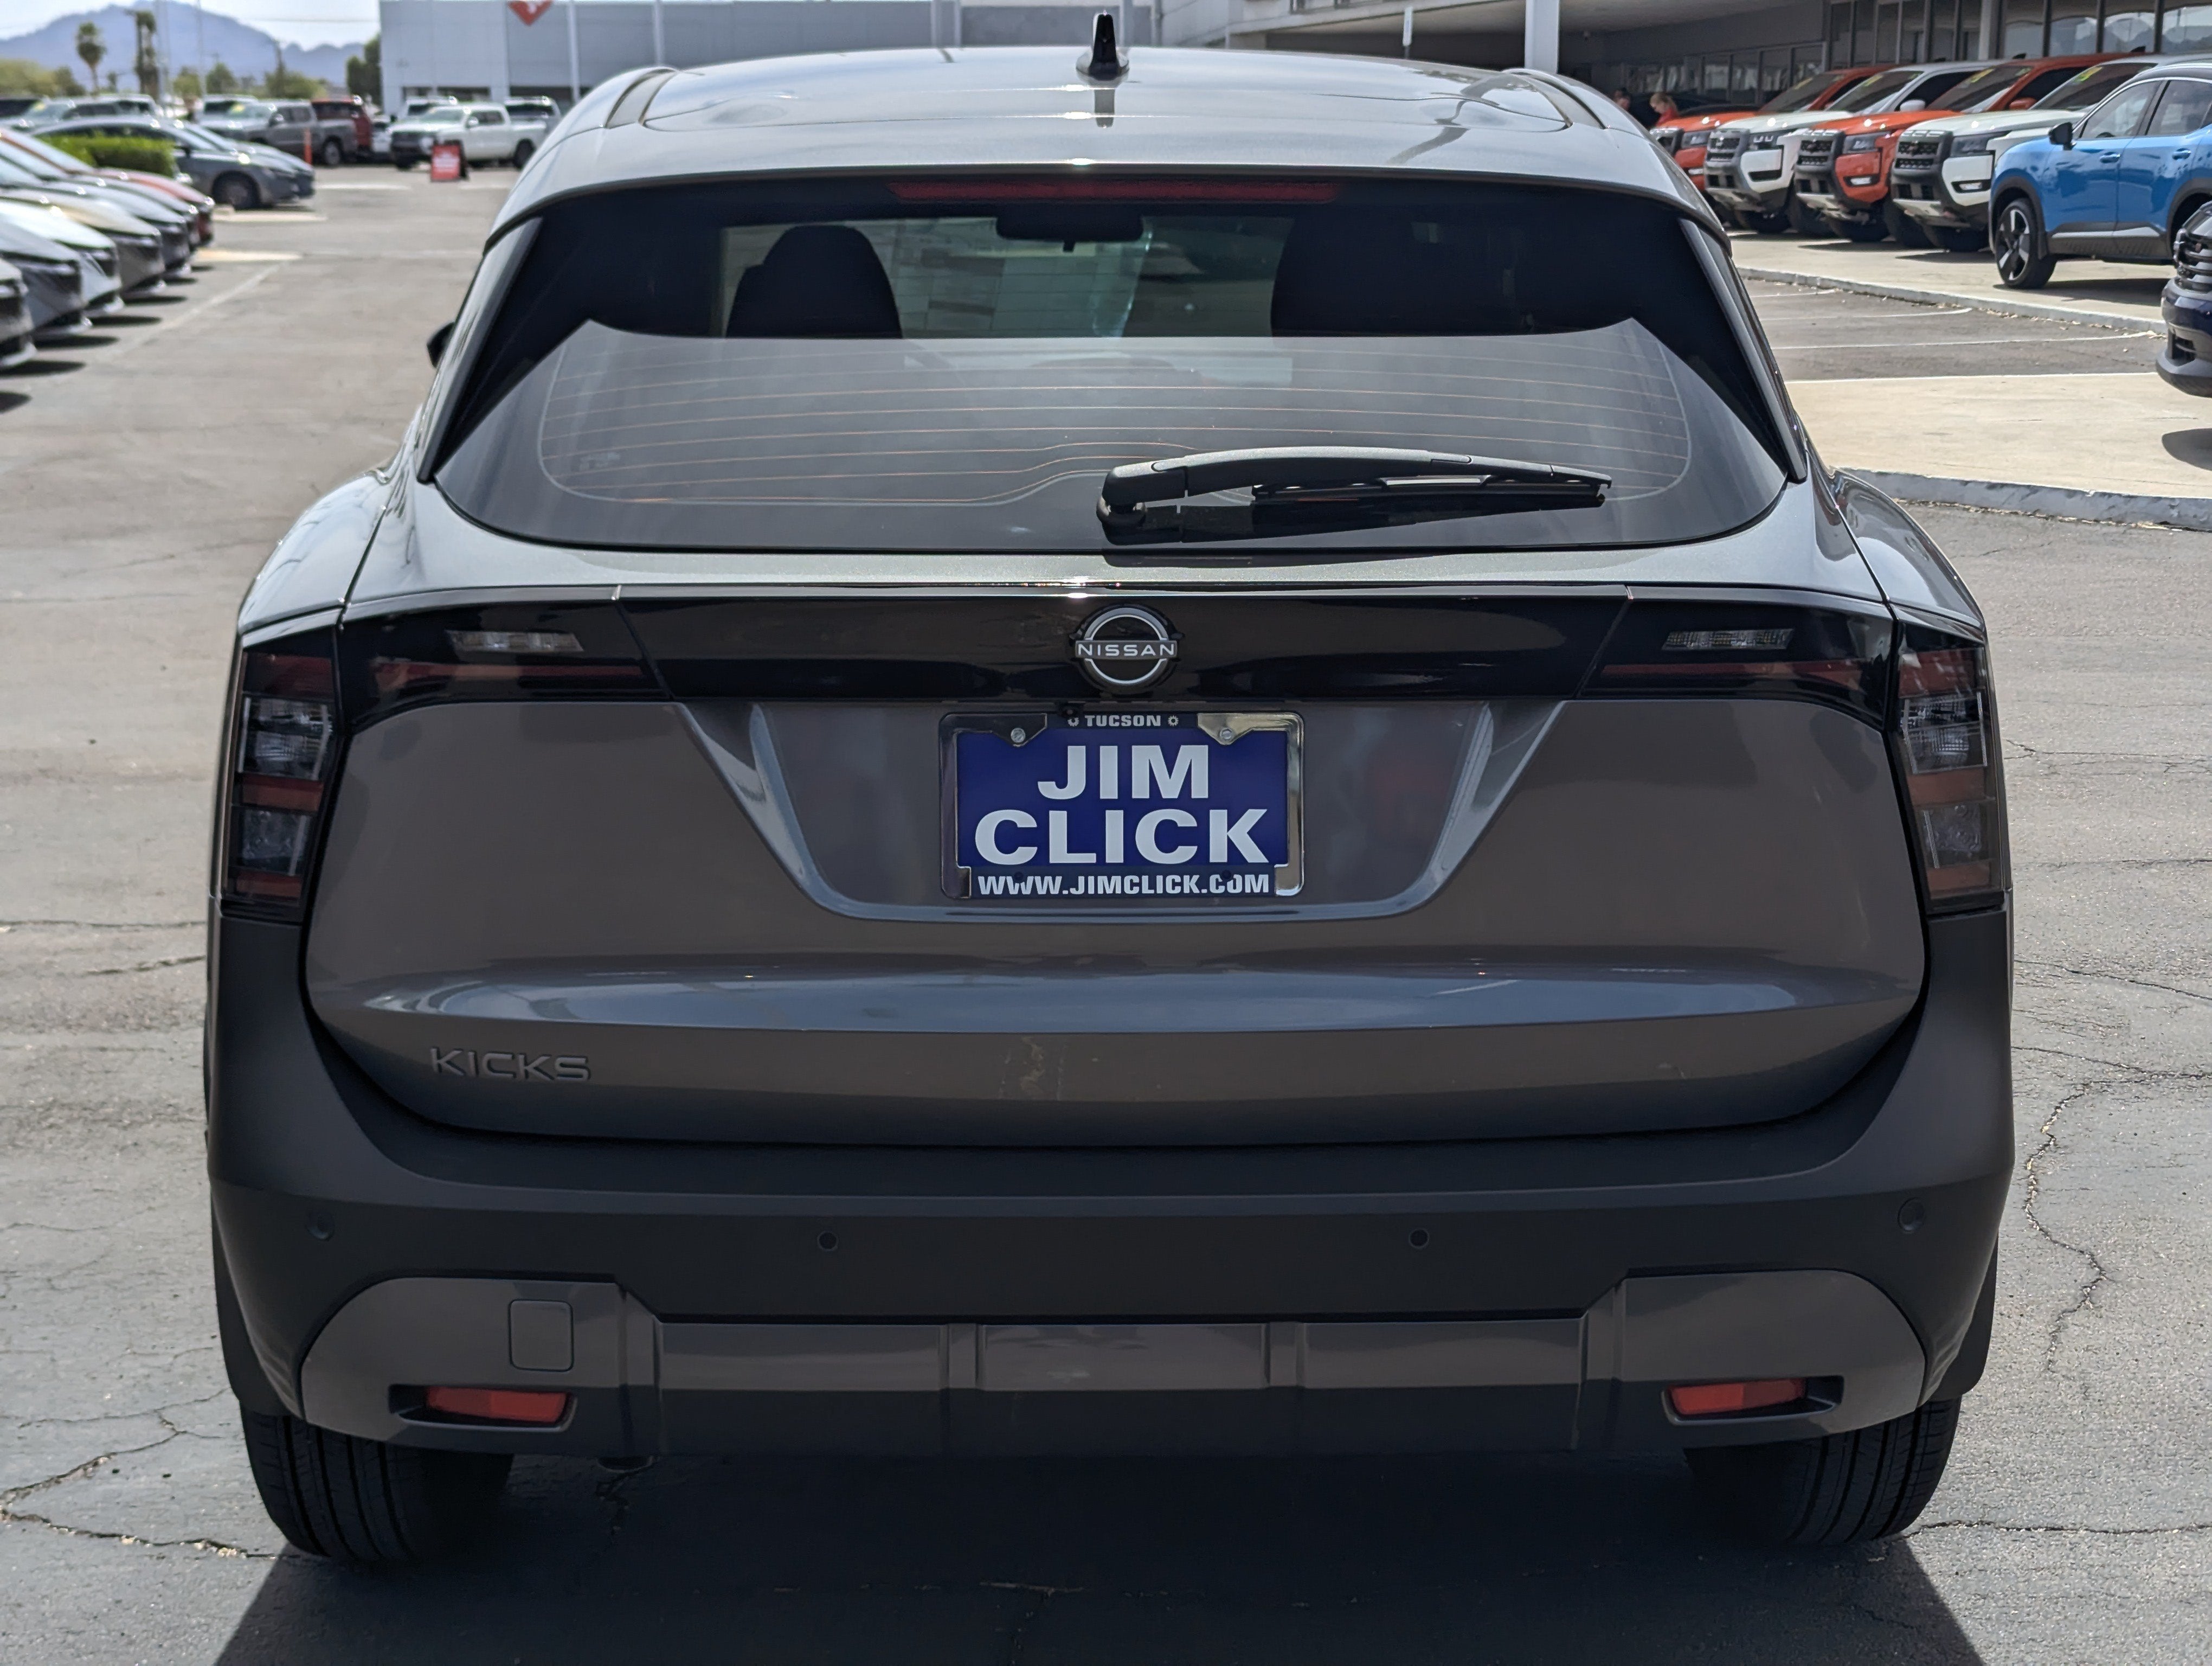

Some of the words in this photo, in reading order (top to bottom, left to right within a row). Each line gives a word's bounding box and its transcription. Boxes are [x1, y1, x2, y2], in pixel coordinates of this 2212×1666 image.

[1078, 644, 1174, 656] NISSAN
[1085, 715, 1161, 727] TUCSON
[1038, 745, 1208, 800] JIM
[975, 809, 1269, 866] CLICK
[978, 874, 1269, 895] WWW.JIMCLICK.COM
[430, 1047, 590, 1081] KICKS
